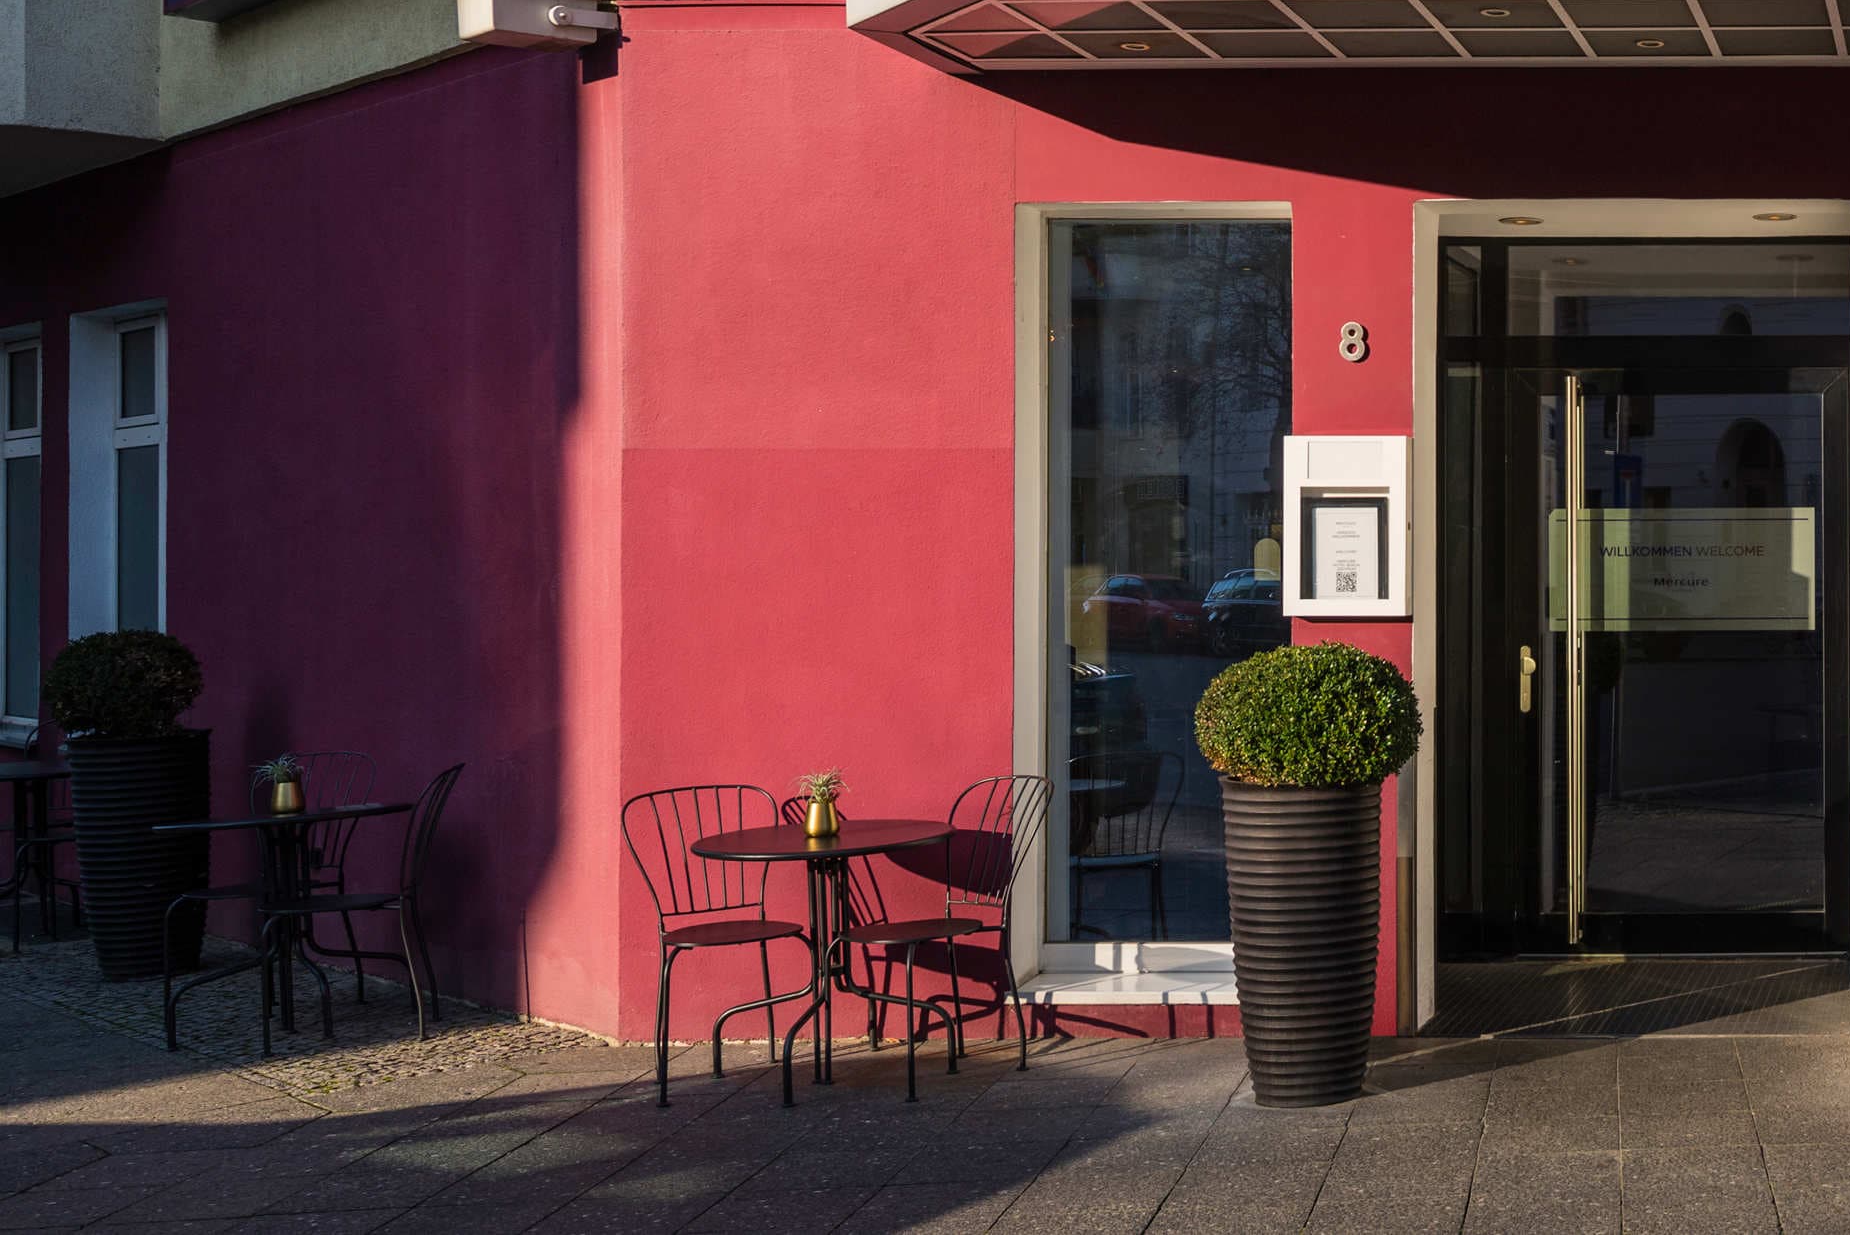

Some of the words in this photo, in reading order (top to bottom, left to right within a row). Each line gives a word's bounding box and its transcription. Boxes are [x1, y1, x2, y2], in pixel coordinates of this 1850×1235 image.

[1339, 321, 1366, 362] 8
[1599, 546, 1692, 557] WILLKOMMEN
[1696, 546, 1765, 557] WELCOME
[1653, 577, 1709, 587] Mercure
